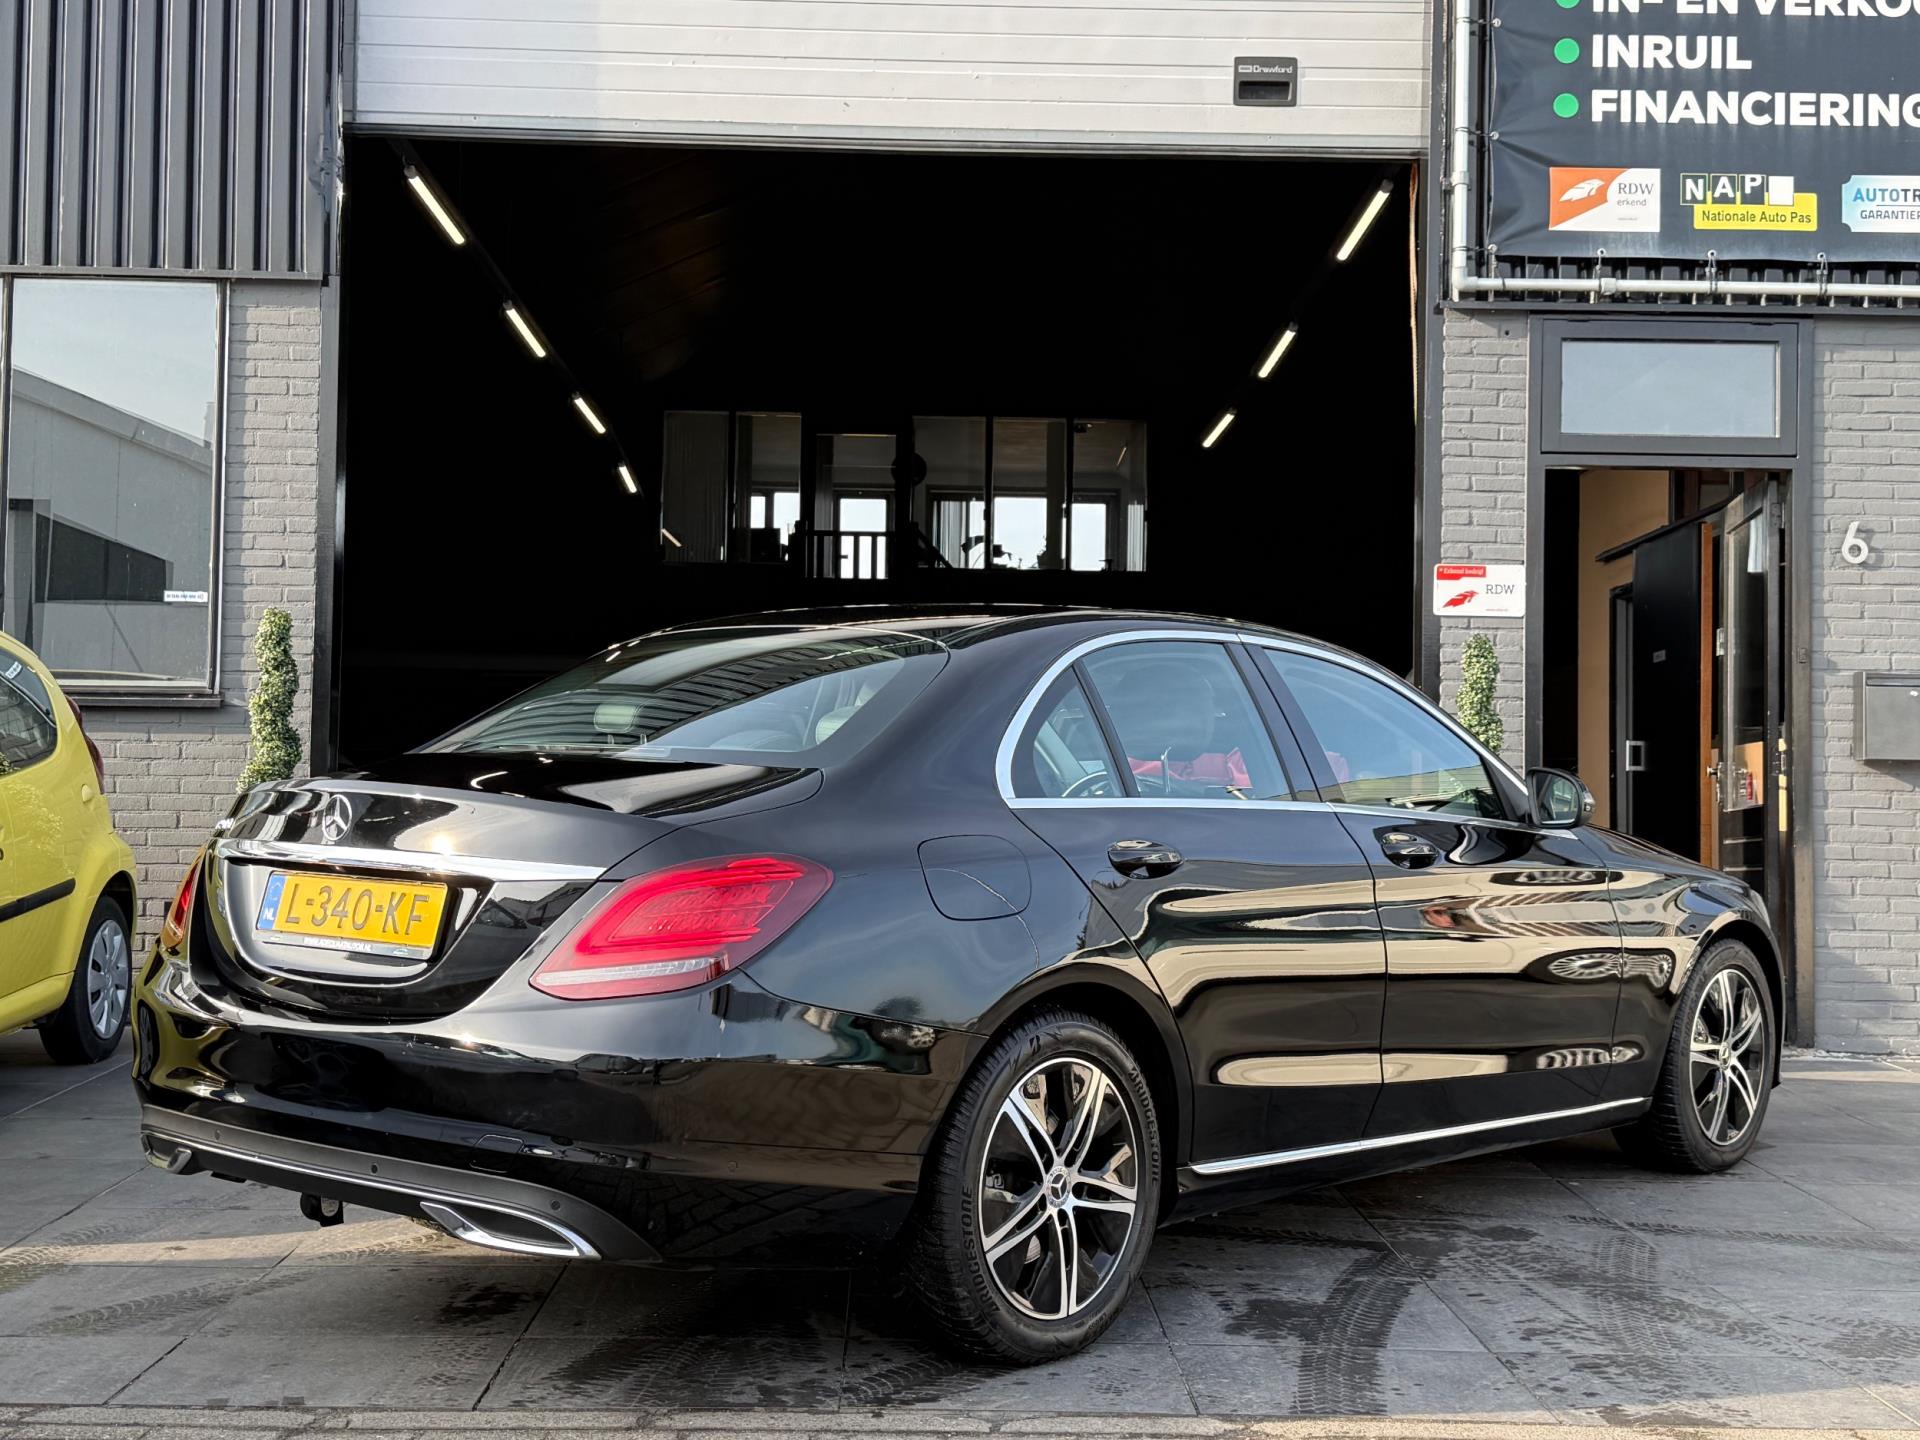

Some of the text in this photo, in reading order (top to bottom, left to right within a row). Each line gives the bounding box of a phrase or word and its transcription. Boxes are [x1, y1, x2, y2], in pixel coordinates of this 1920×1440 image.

[1592, 34, 1753, 70] INRUIL
[1618, 182, 1654, 195] RDW
[1684, 174, 1762, 201] NAP
[1616, 198, 1647, 207] erkend
[1702, 210, 1812, 224] Nationale Auto Pas
[1841, 520, 1869, 564] 6
[1485, 584, 1515, 595] RDW
[262, 907, 275, 920] NL
[285, 883, 430, 936] L-340-KF
